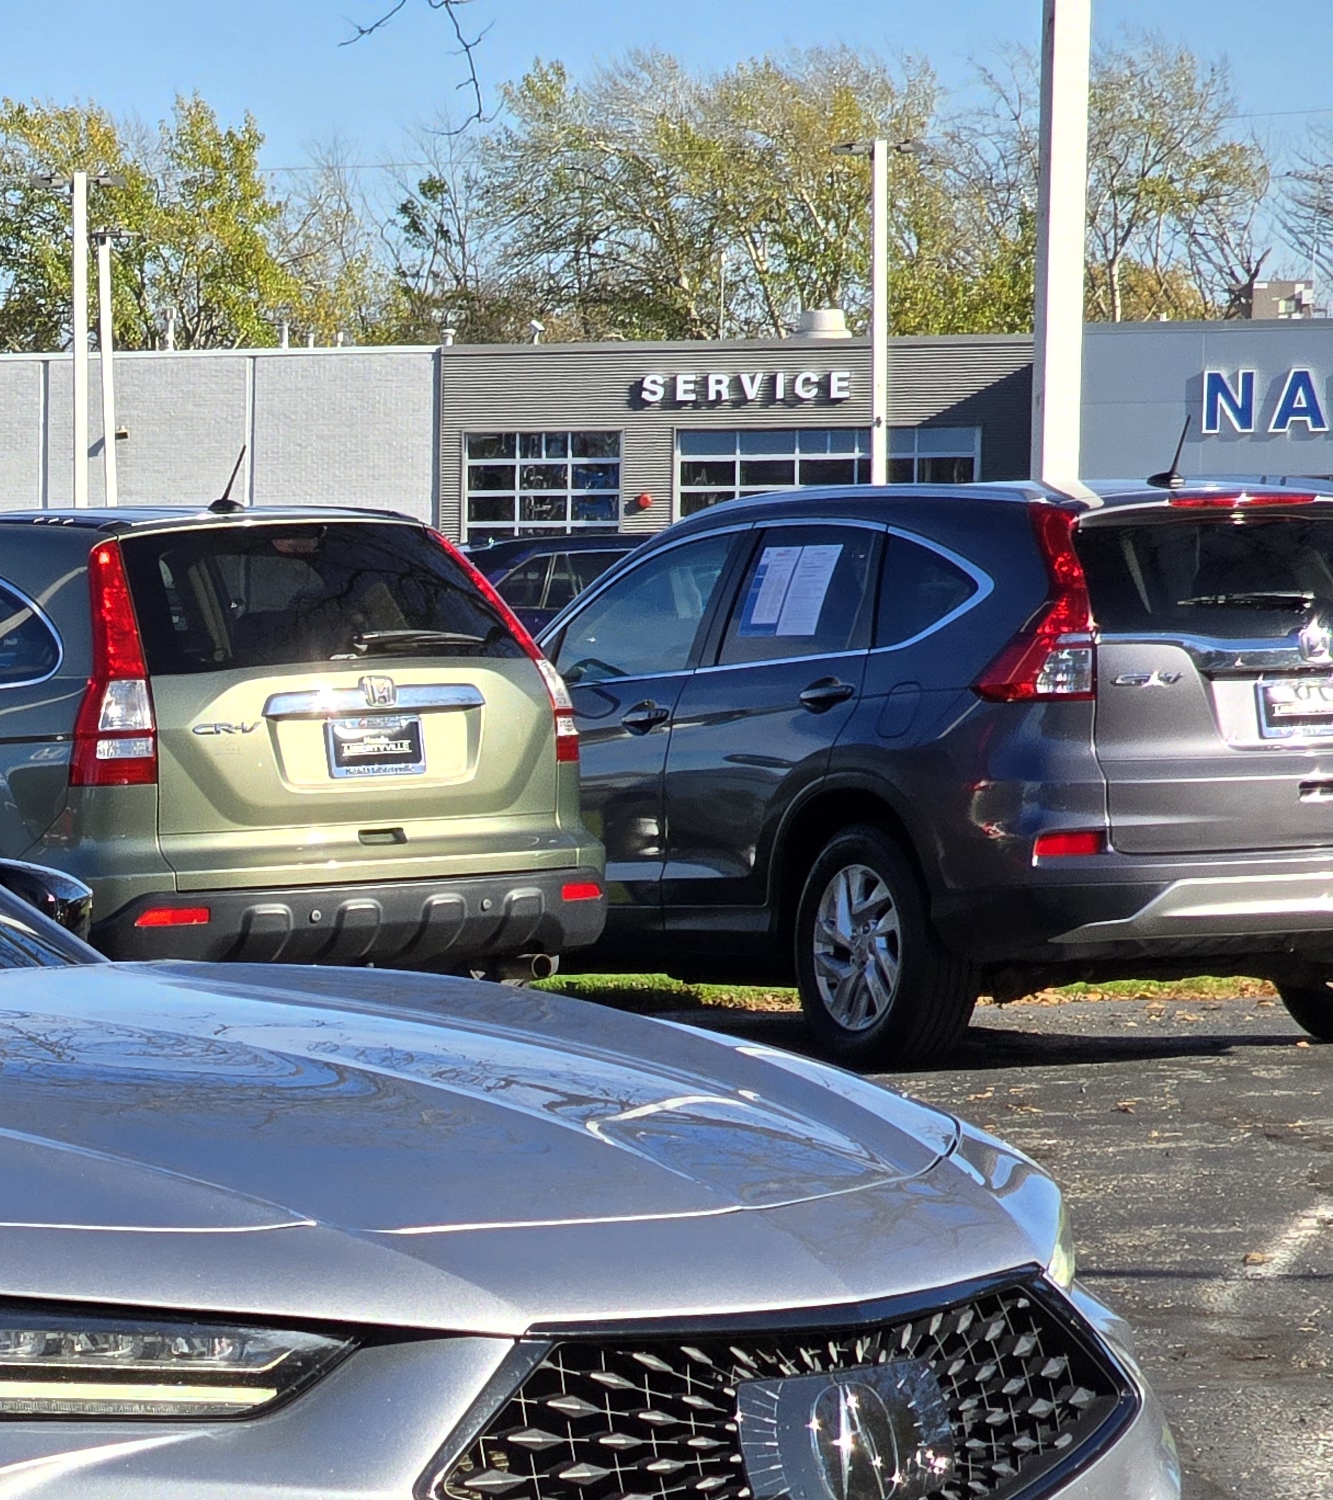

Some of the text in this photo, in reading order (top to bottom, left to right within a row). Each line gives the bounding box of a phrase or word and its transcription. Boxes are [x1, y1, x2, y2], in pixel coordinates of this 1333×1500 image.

[641, 371, 851, 402] SERVICE
[1202, 368, 1330, 434] NA
[1110, 669, 1183, 688] CV
[192, 721, 262, 736] CR-V
